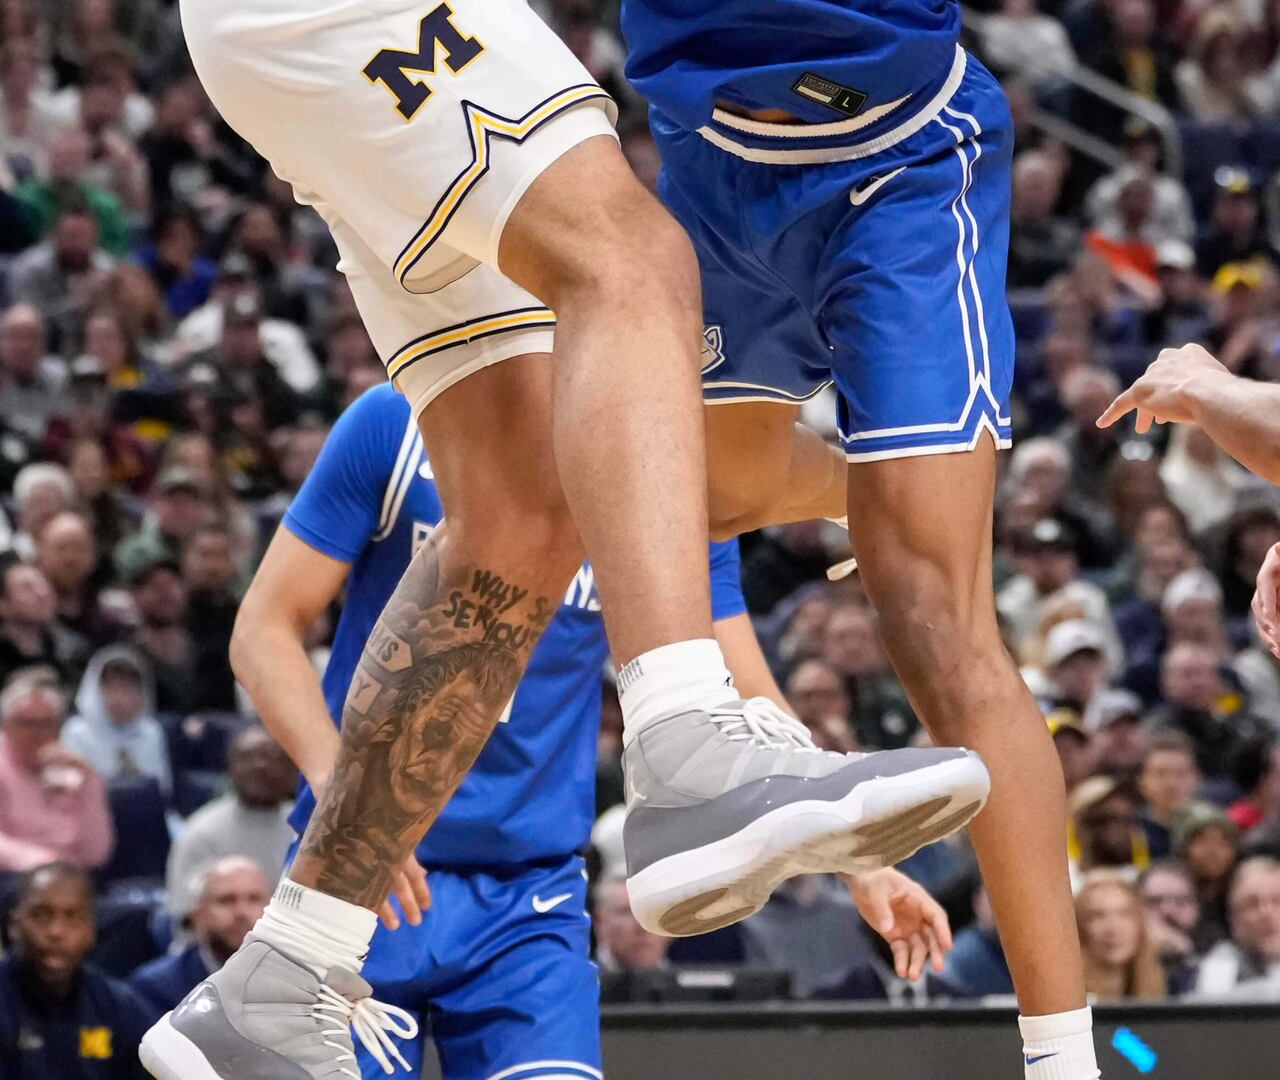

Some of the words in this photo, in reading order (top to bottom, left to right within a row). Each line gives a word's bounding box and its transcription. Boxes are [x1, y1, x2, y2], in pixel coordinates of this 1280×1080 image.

[361, 1, 486, 122] M
[841, 95, 850, 108] L
[471, 569, 529, 615] WHY
